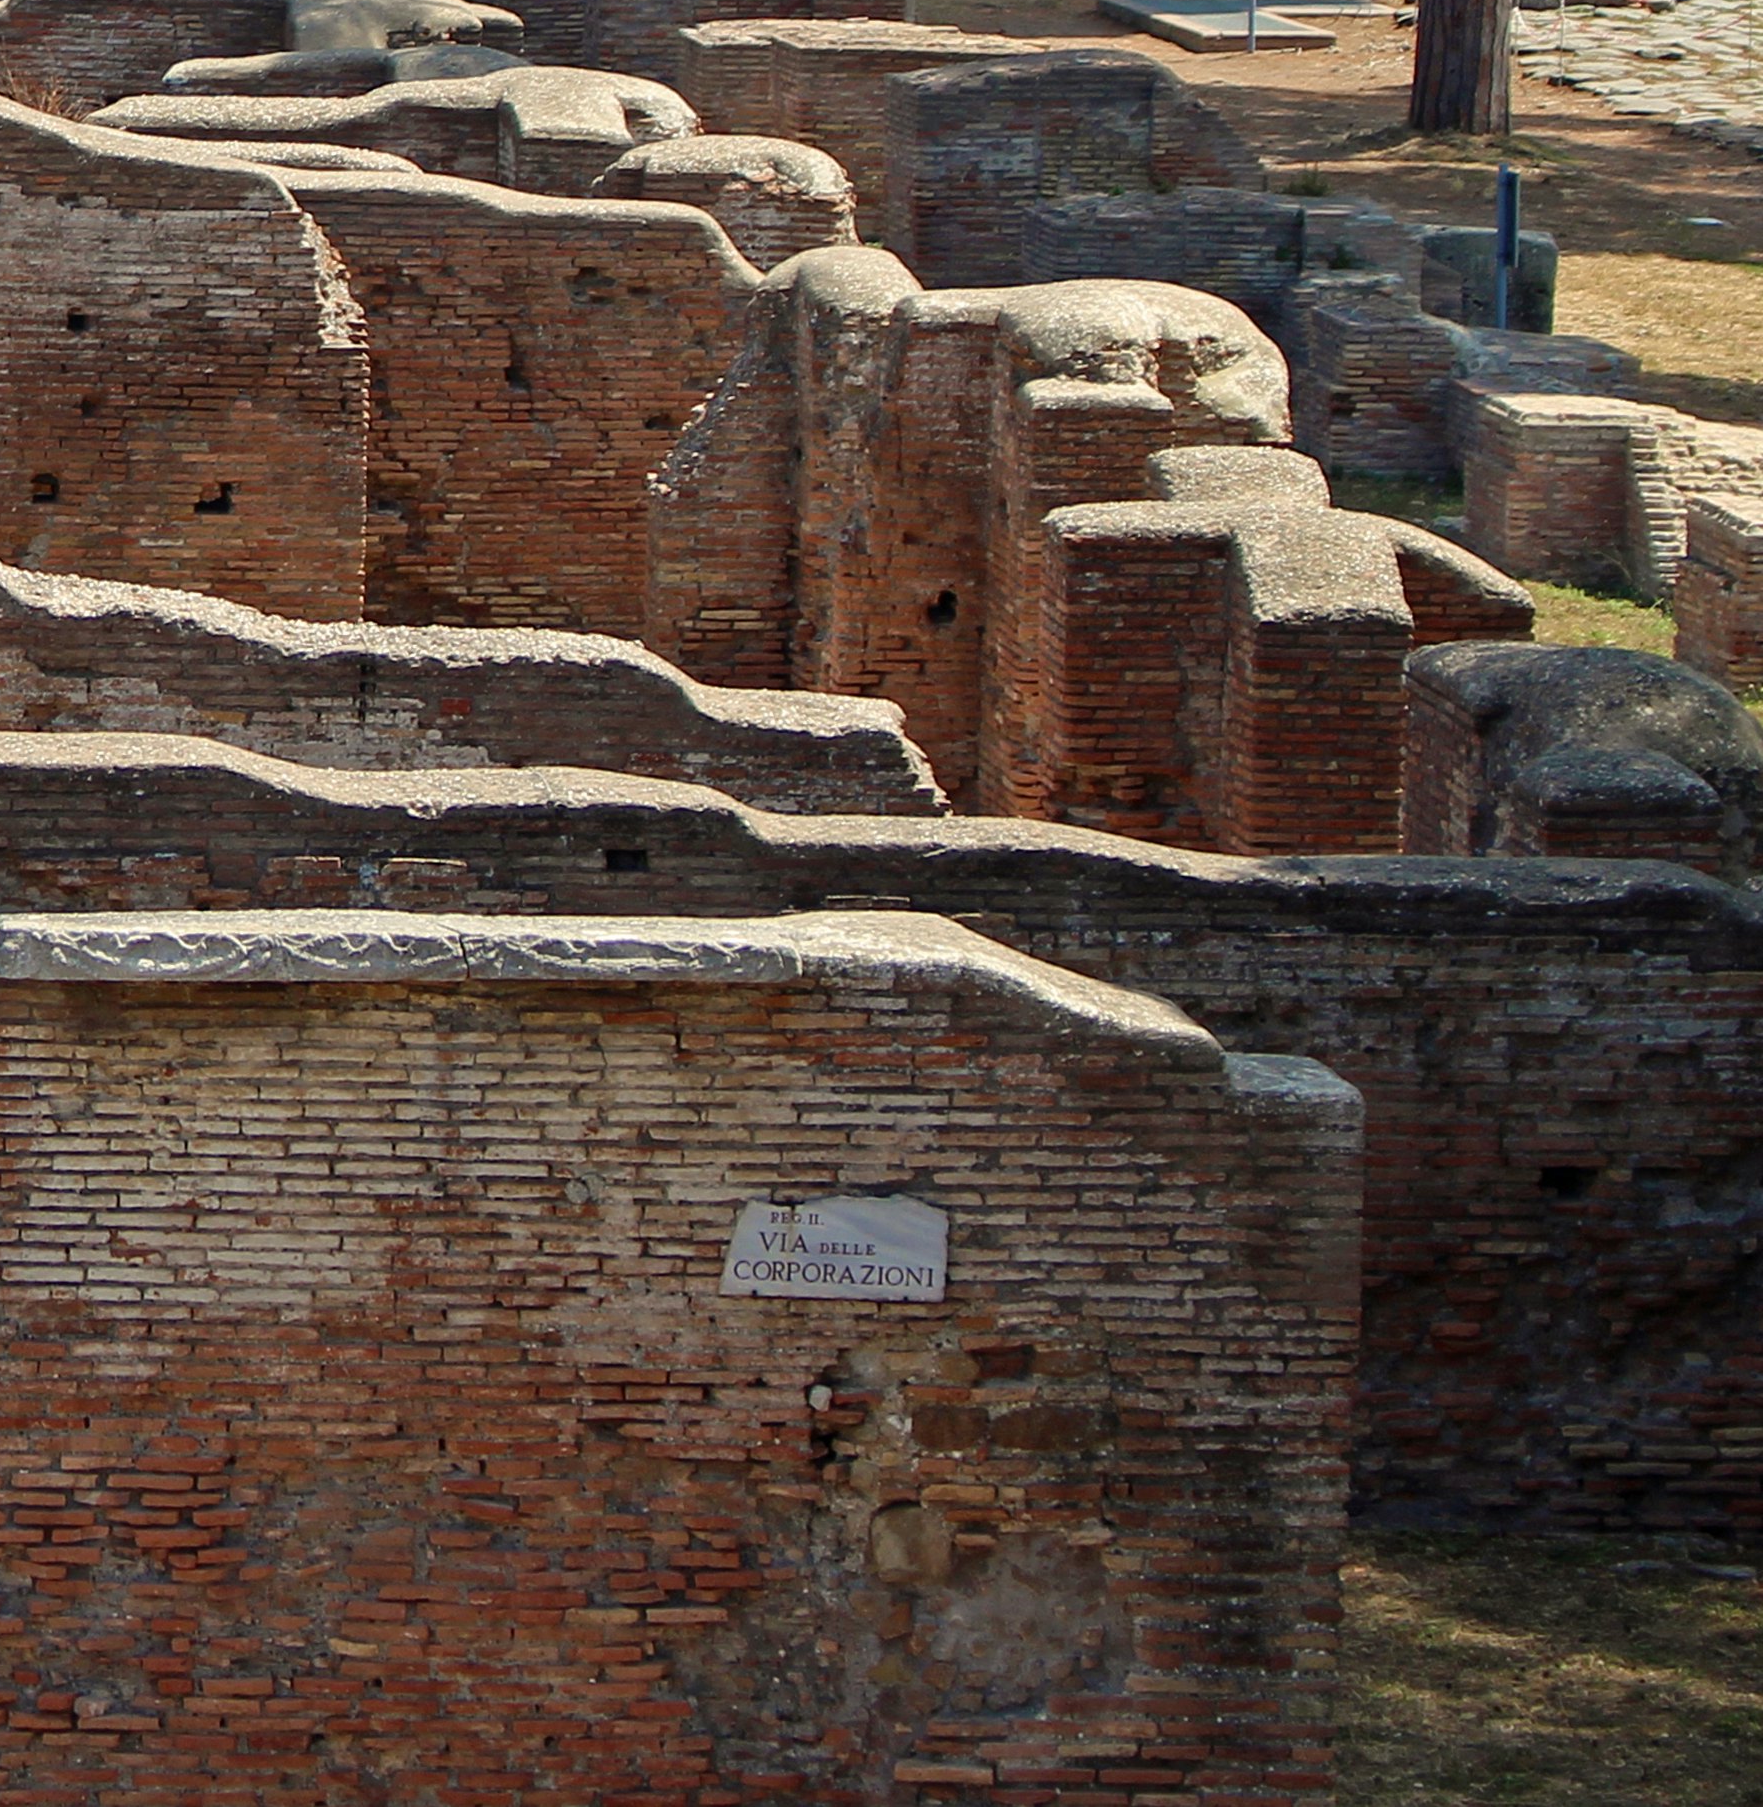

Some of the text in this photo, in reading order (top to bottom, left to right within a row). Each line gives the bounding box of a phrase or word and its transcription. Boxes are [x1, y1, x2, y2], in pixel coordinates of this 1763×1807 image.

[759, 1231, 877, 1256] VIA DELLE
[733, 1259, 935, 1289] CORPORAZIONI
